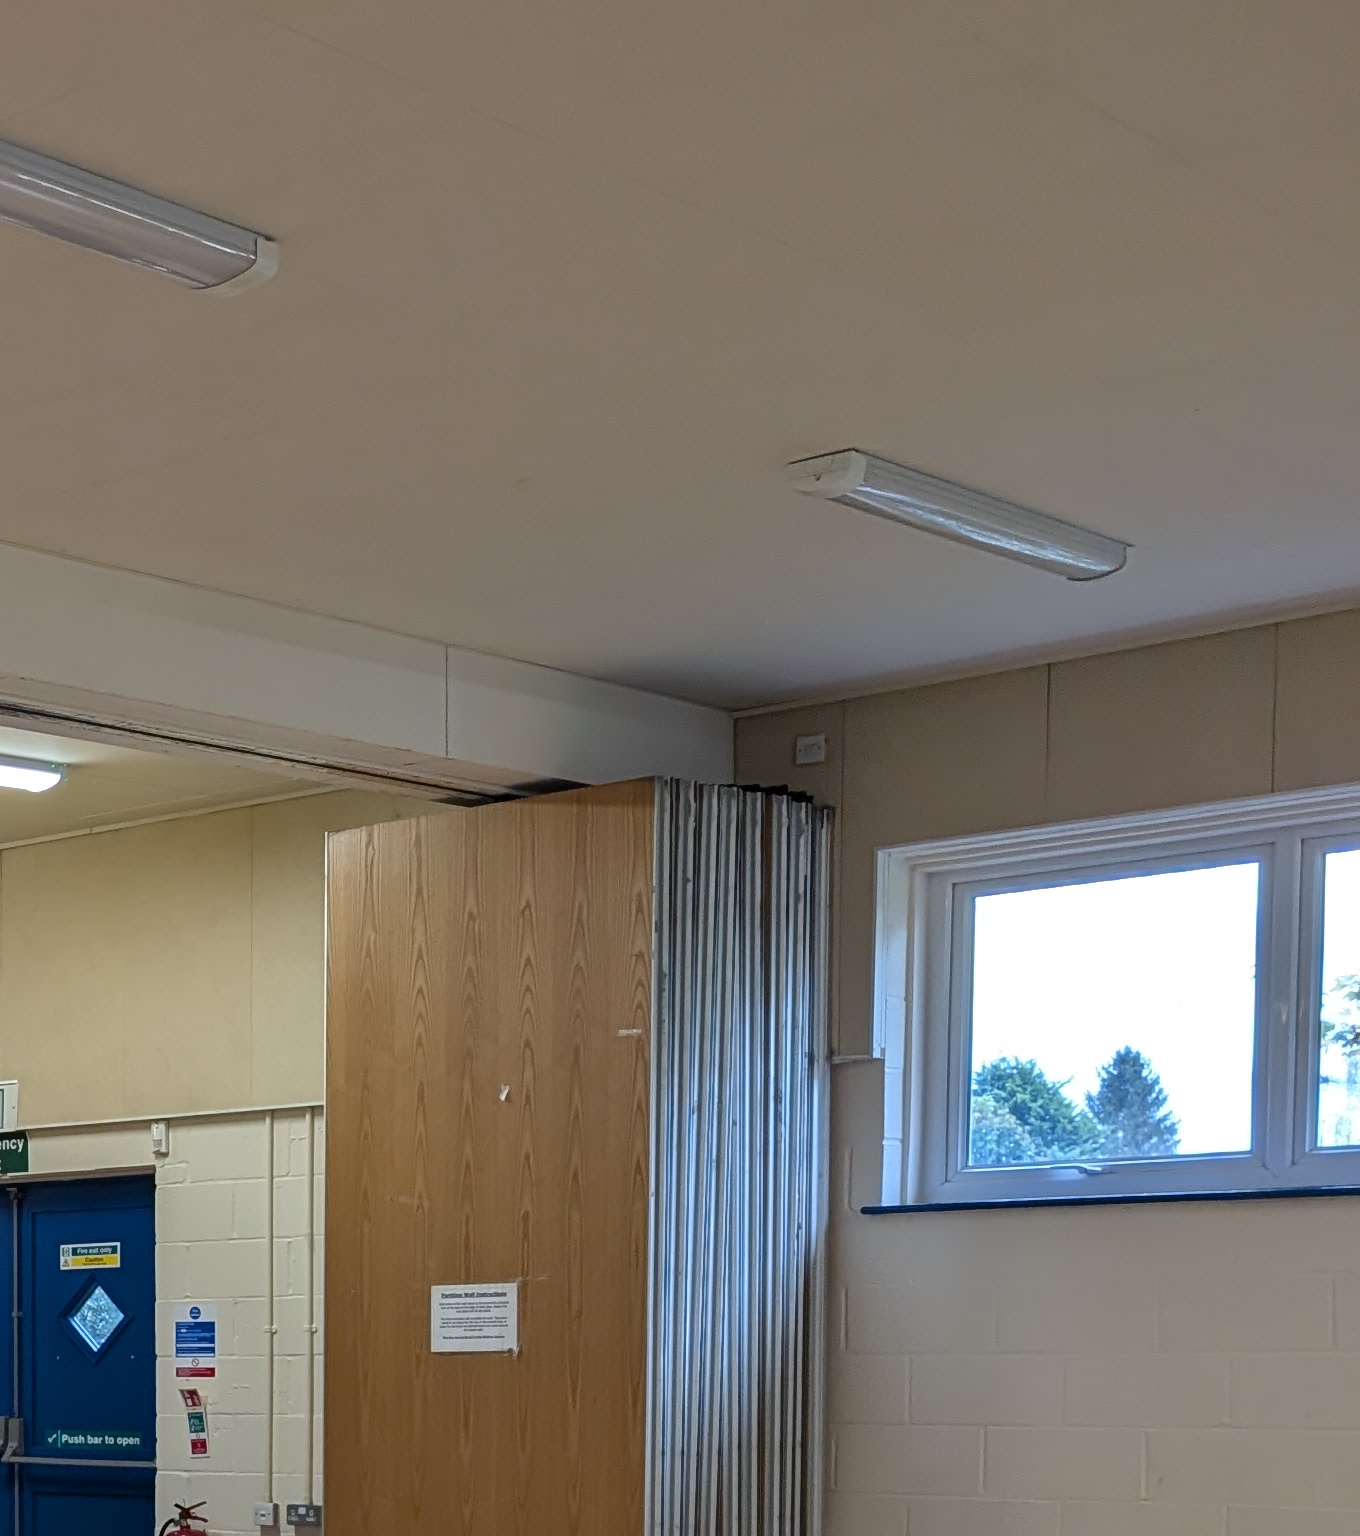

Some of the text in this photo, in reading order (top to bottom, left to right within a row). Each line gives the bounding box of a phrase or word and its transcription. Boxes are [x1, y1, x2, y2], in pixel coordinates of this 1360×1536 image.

[77, 1247, 88, 1255] Fire
[62, 1434, 140, 1447] Push bar to open
